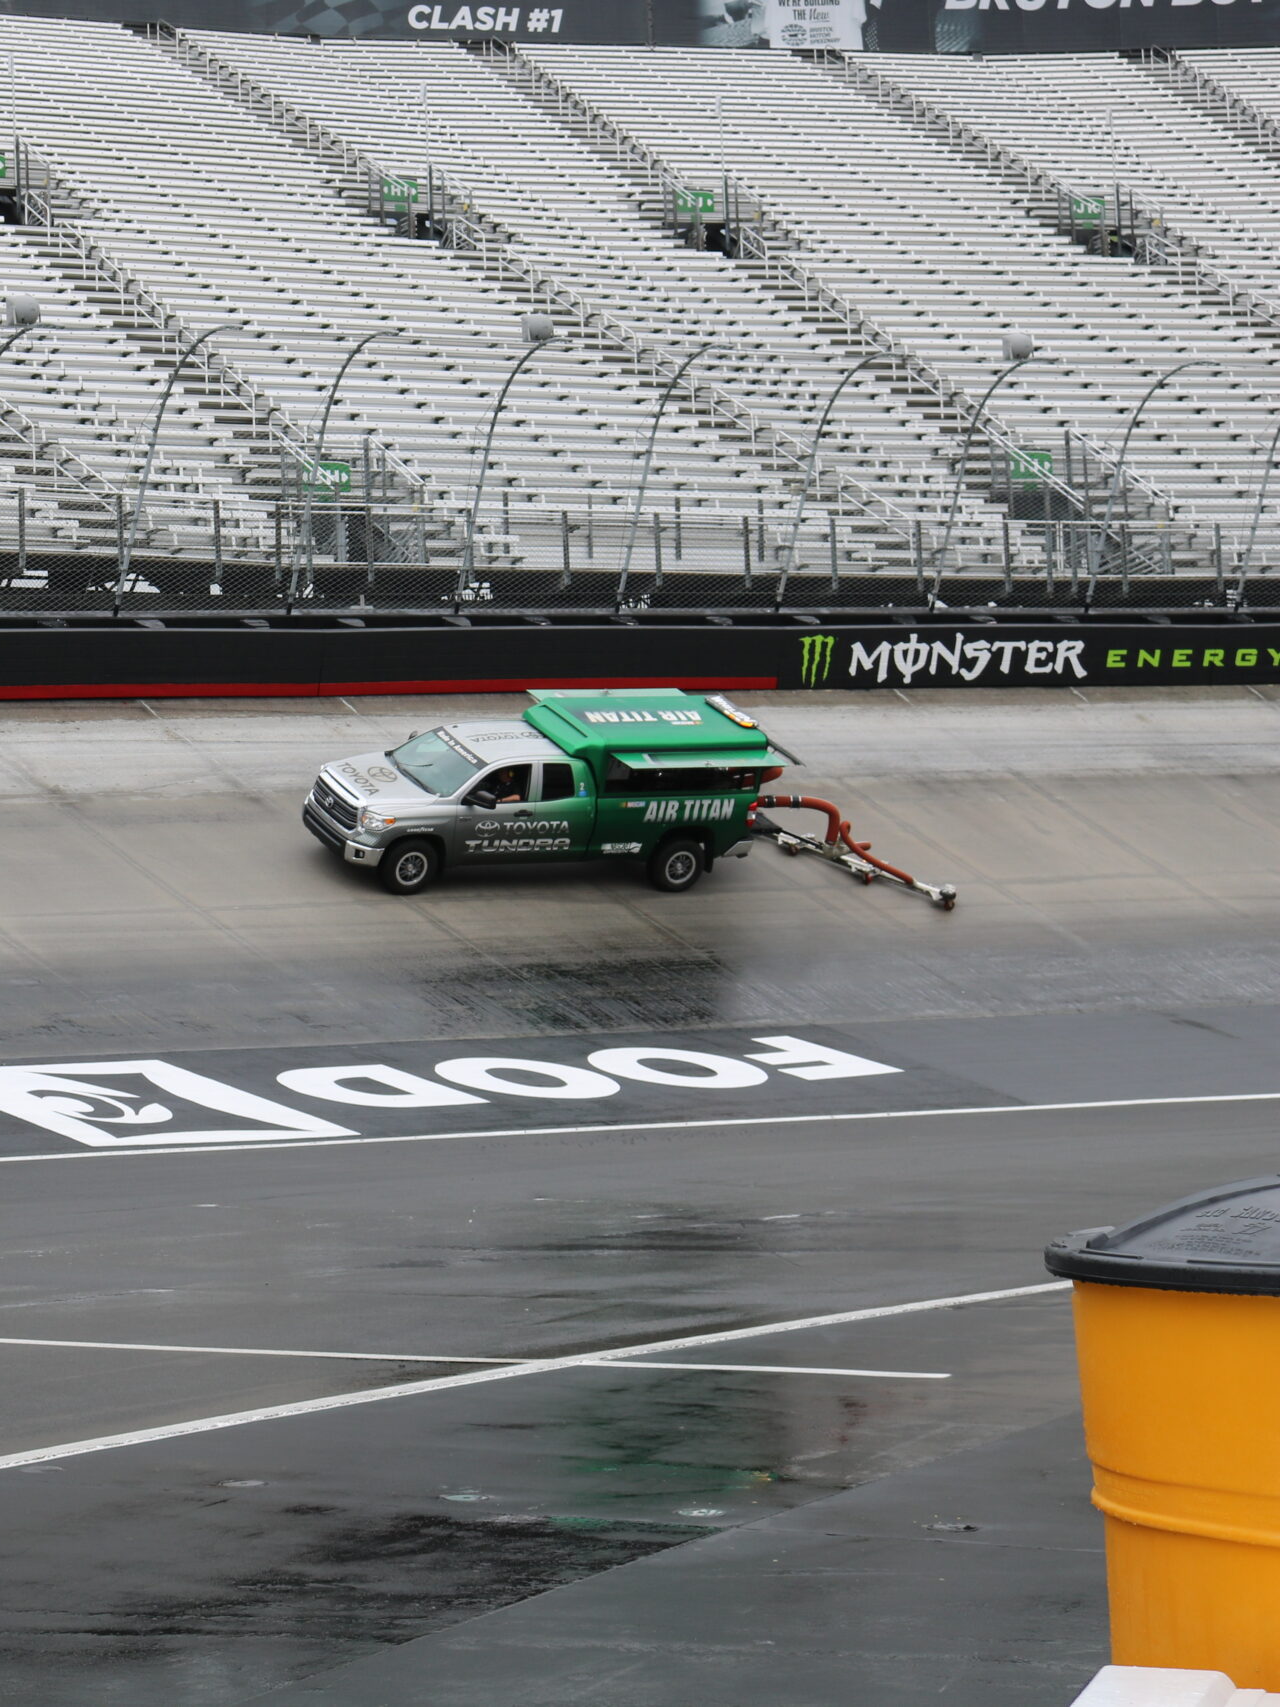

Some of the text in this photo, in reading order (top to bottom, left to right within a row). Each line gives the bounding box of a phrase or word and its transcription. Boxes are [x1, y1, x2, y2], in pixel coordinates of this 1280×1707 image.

[407, 5, 563, 33] CLASH #1
[792, 9, 806, 21] THE
[1106, 649, 1280, 668] ENERGY
[584, 710, 702, 723] AIR TITAN
[453, 745, 478, 764] America
[336, 762, 380, 796] TOYOTA
[643, 799, 735, 823] AIR TITAN
[503, 821, 569, 836] TOYOTA
[465, 838, 571, 853] TUNDRA
[276, 1035, 906, 1107] FOOD
